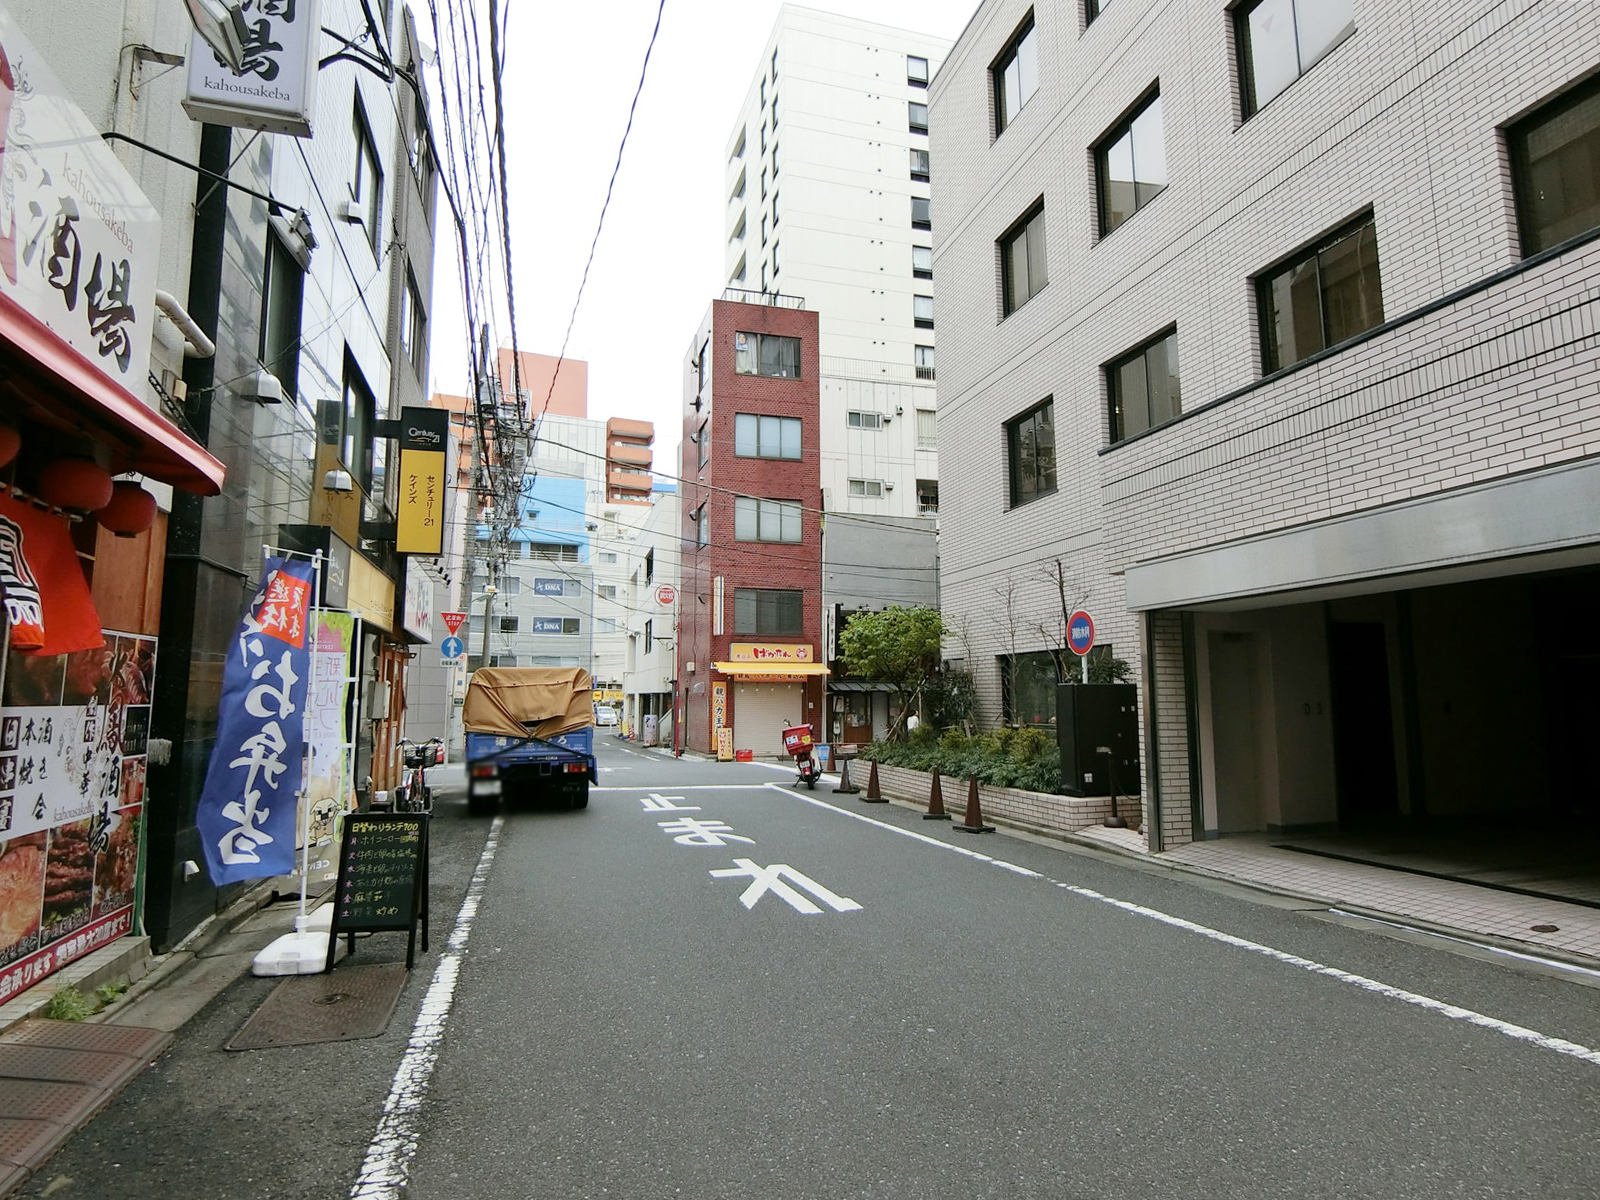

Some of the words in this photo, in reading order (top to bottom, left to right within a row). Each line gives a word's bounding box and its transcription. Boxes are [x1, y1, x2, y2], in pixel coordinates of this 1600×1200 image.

[204, 76, 291, 101] kahousakeba
[62, 152, 135, 255] kahousakeba
[408, 427, 435, 439] Century
[408, 474, 418, 505] ケインズ
[424, 475, 436, 527] センチュリー21
[545, 583, 561, 591] DNA
[543, 622, 560, 630] DNA
[3, 716, 54, 751] 日本酒
[639, 793, 865, 916] 止まれ
